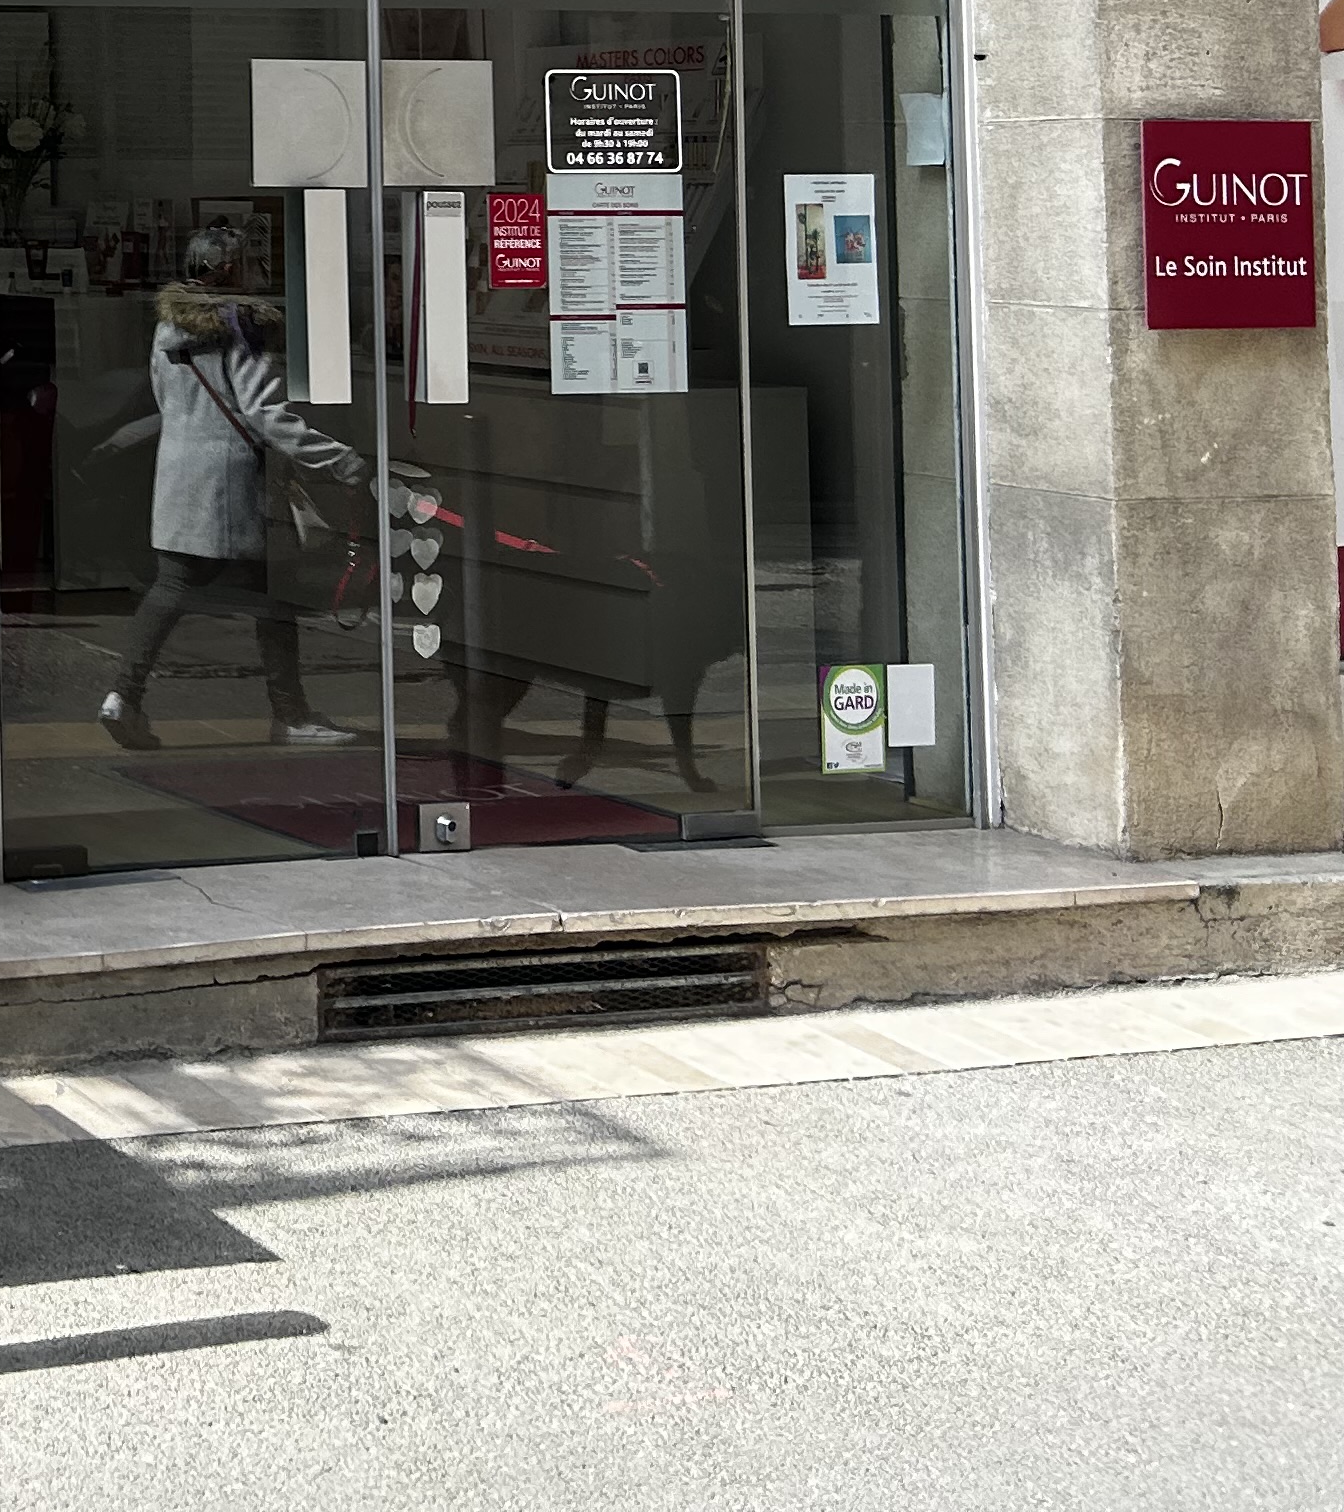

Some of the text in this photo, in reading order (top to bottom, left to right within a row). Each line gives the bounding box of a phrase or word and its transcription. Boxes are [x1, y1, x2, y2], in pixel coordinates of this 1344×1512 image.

[575, 45, 705, 70] MASTERS COLORS
[569, 75, 657, 101] GUINOT
[569, 117, 605, 126] Horaires
[575, 129, 586, 137] du
[587, 128, 612, 137] mardi
[625, 128, 654, 137] samedi
[581, 139, 592, 148] de
[566, 152, 664, 165] 04 66 36 87 74
[594, 181, 636, 195] GUINOT
[1149, 157, 1309, 207] GUINOT
[493, 198, 541, 223] 2024
[1175, 213, 1289, 223] INSTITUT PARIS
[493, 225, 542, 237] INSTITUT DE
[495, 253, 542, 268] GUINOT
[1155, 254, 1308, 277] Le Soin Institut
[834, 681, 873, 694] Made in
[833, 695, 874, 711] GARD
